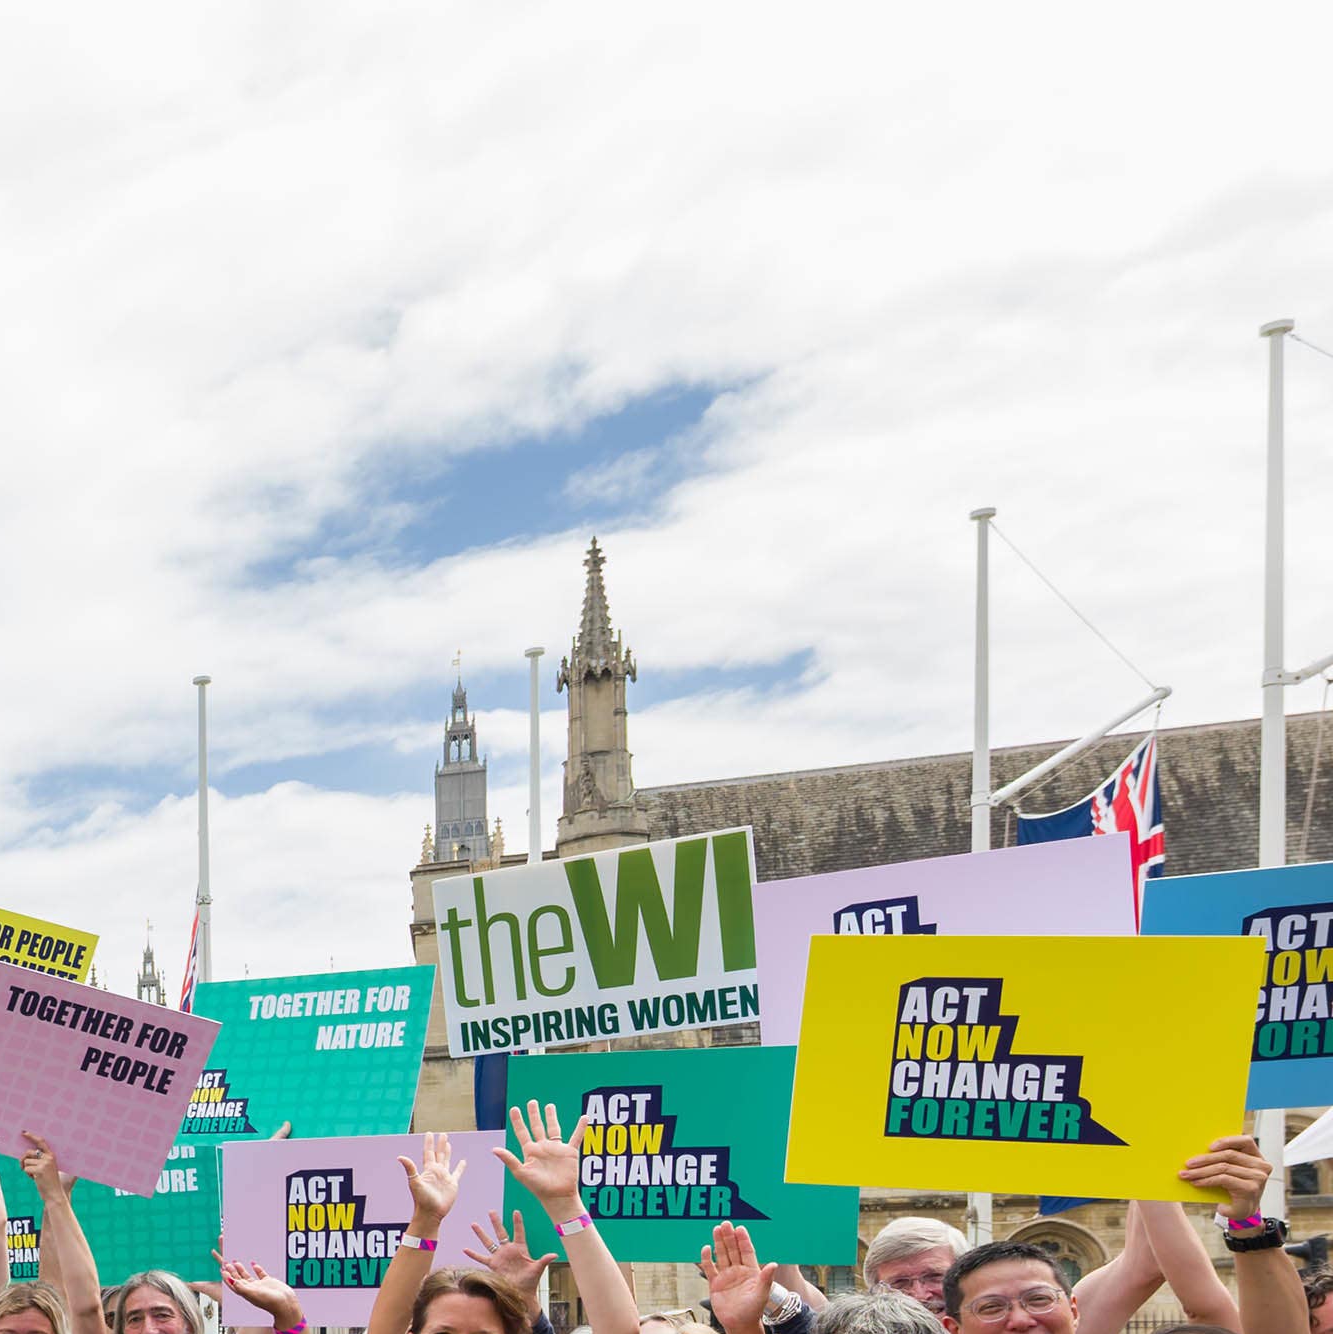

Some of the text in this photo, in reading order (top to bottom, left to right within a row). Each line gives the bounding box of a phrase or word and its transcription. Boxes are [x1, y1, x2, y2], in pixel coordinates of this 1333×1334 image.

[441, 831, 756, 1008] theWI
[1248, 911, 1333, 951] ACT
[15, 930, 86, 969] PEOPLE
[249, 985, 411, 1020] TOGETHER FOR
[461, 984, 759, 1051] INSPIRING WOMEN
[900, 986, 988, 1023] ACT
[6, 986, 188, 1059] TOGETHER FOR
[315, 1022, 406, 1050] NATURE
[896, 1023, 1001, 1061] NOW
[81, 1047, 175, 1095] PEOPLE
[892, 1061, 1066, 1102] CHANGE
[186, 1102, 243, 1118] CHANGE
[190, 1088, 225, 1103] NOW
[586, 1093, 651, 1124] ACT
[183, 1118, 245, 1132] FOREVER
[887, 1097, 1081, 1140] FOREVER
[582, 1124, 664, 1155] NOW
[581, 1154, 717, 1186] CHANGE
[289, 1176, 344, 1204] ACT
[585, 1186, 731, 1217] FOREVER
[6, 1220, 30, 1234] ACT
[288, 1203, 355, 1231] NOW
[7, 1234, 37, 1248] NOW
[287, 1230, 403, 1259] CHANGE
